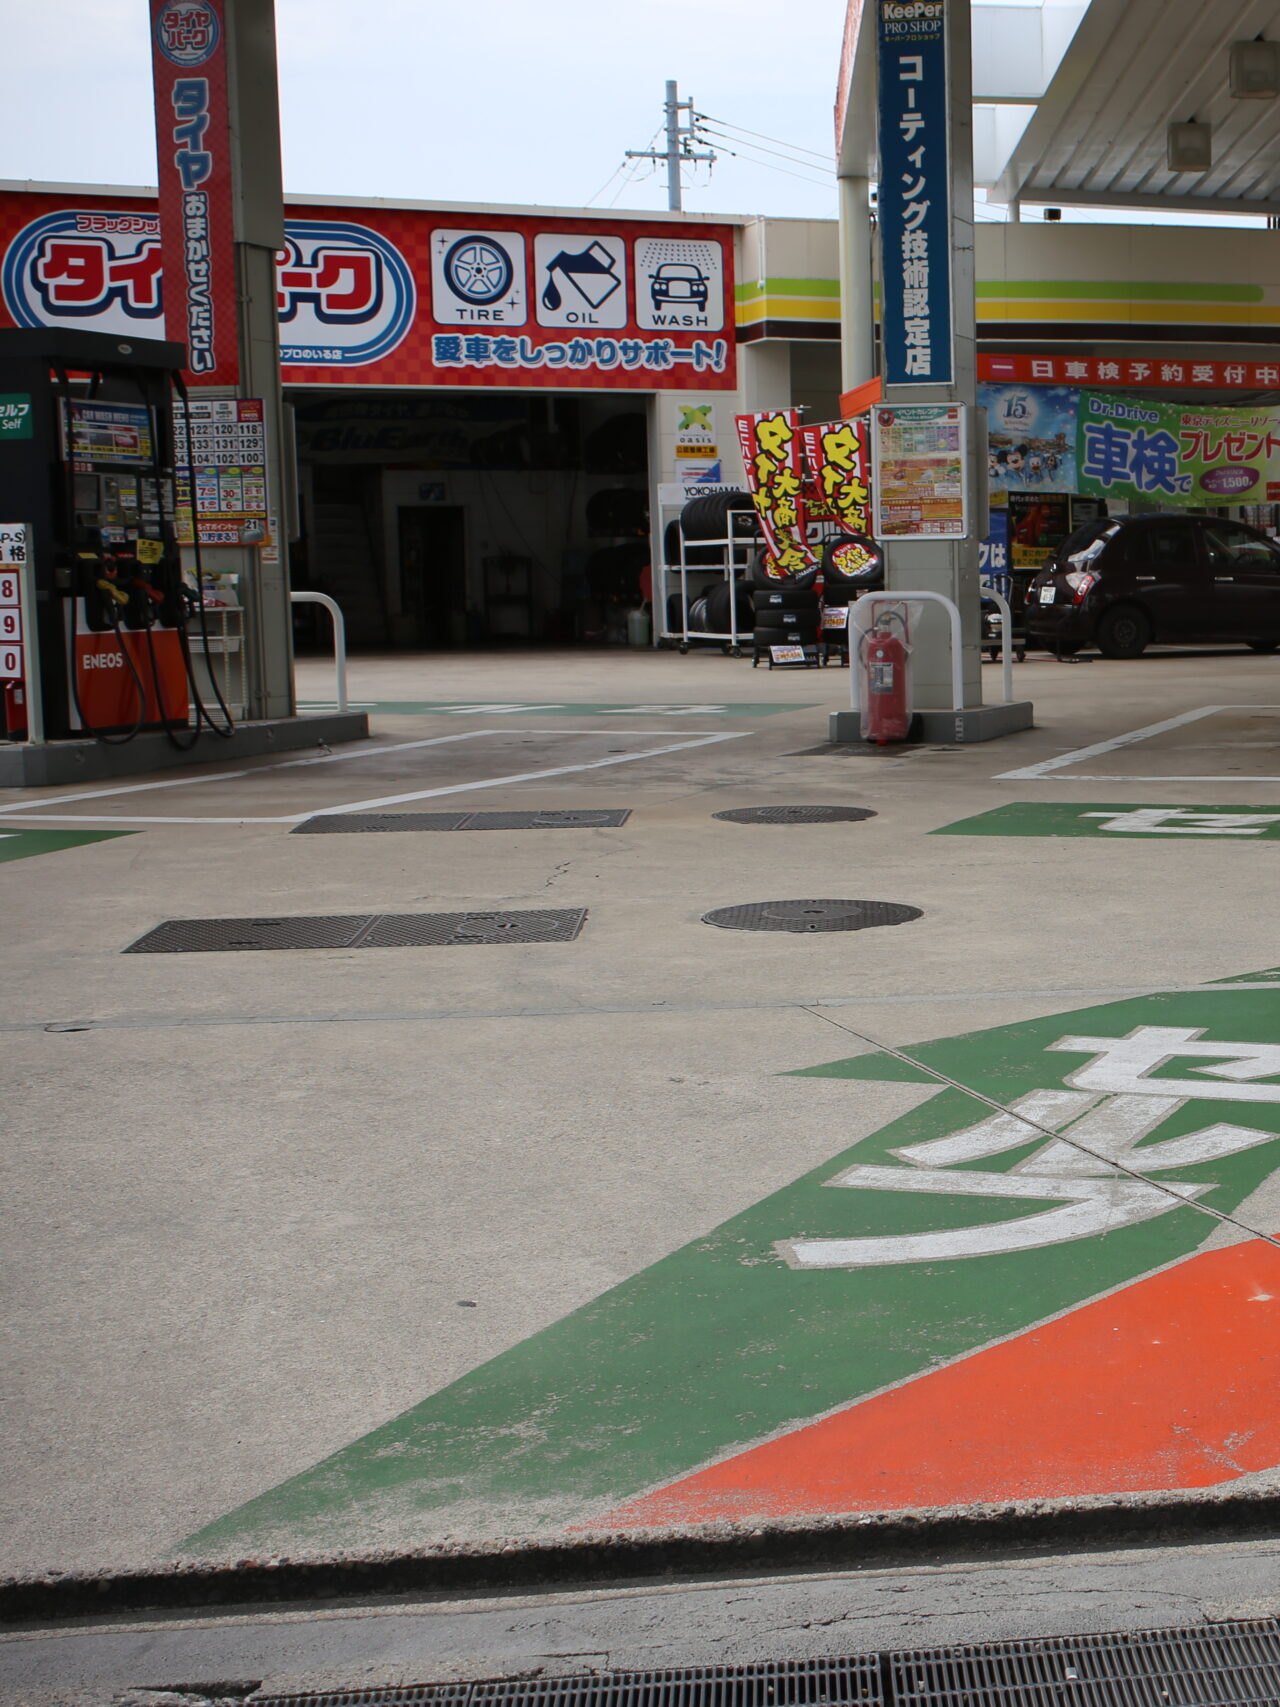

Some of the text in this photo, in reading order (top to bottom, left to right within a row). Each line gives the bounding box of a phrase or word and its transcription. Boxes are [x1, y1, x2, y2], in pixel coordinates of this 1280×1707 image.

[884, 2, 942, 19] KeePer
[163, 10, 211, 30] タイヤ
[885, 20, 941, 34] PRO SHOP
[167, 28, 208, 48] パーク
[77, 215, 160, 233] フラッグシッ
[899, 55, 932, 377] コーティング技術認定店
[456, 308, 504, 321] TIRE
[566, 312, 599, 324] OIL
[652, 315, 708, 327] WASH
[433, 336, 726, 372] 愛車をしっかりサポート!
[991, 360, 1280, 385] 一日車検予約受付中
[1090, 398, 1159, 423] Dr.Drive
[2, 418, 22, 430] Self
[215, 424, 233, 435] 120
[240, 424, 258, 435] 118
[215, 439, 233, 449] 131
[240, 439, 258, 449] 129
[216, 454, 234, 464] 102
[240, 454, 259, 464] 100
[684, 486, 740, 497] YOKOHAMA
[245, 520, 257, 529] 21
[2, 579, 13, 598] 8
[4, 615, 15, 634] 9
[5, 653, 16, 671] 0
[83, 653, 123, 670] ENEOS
